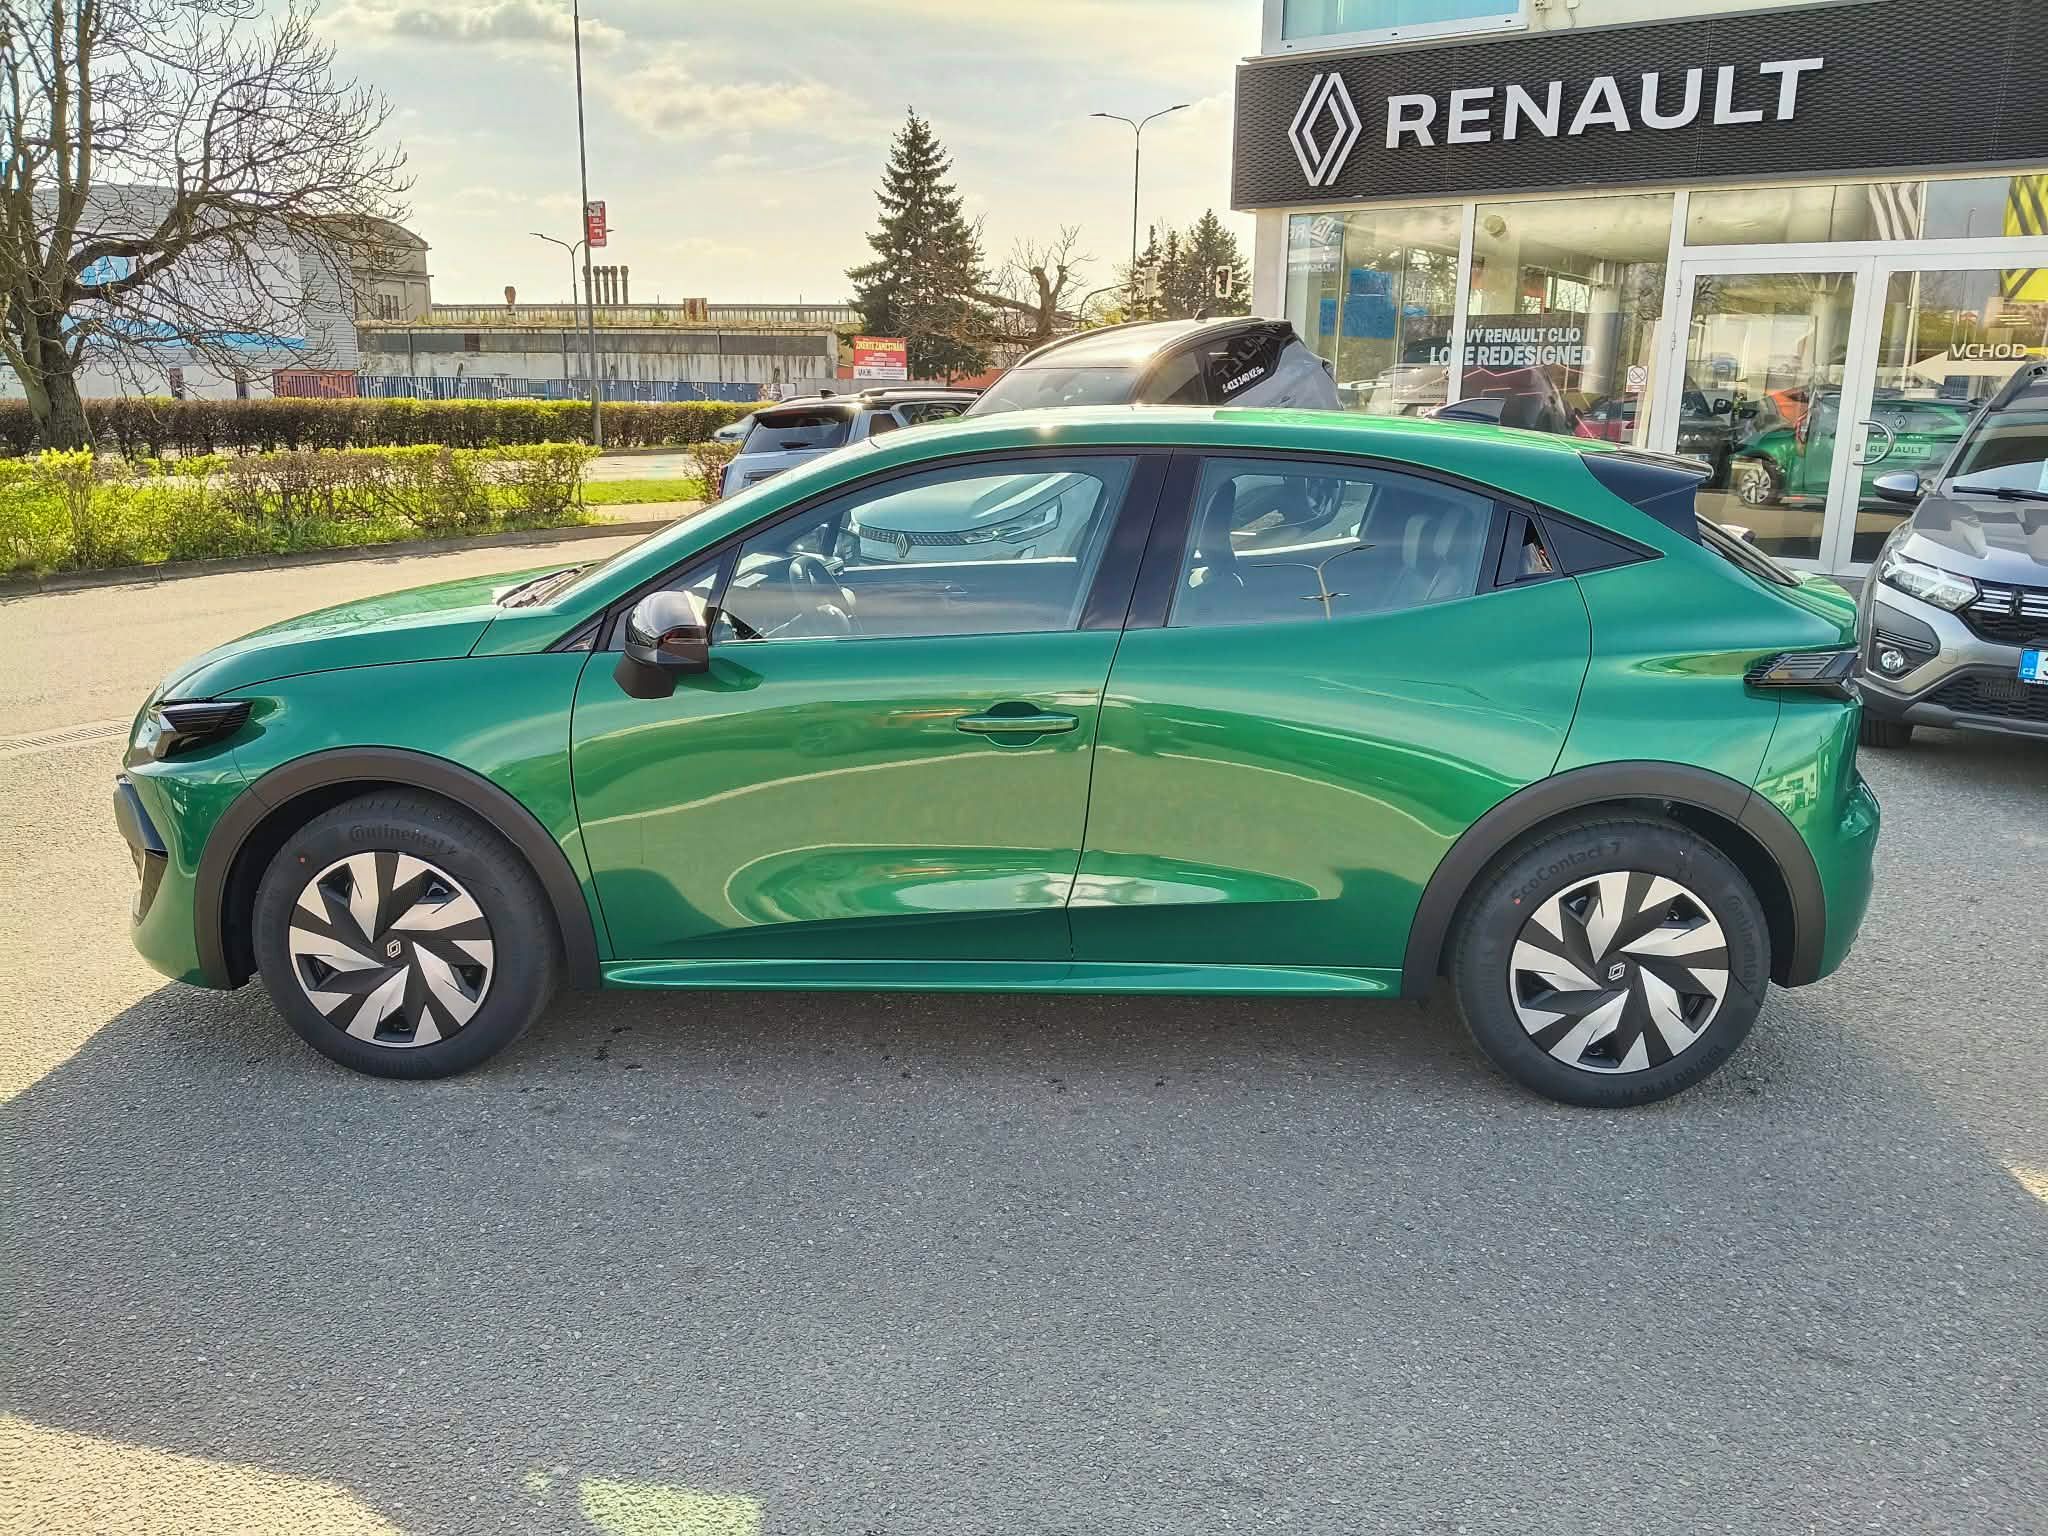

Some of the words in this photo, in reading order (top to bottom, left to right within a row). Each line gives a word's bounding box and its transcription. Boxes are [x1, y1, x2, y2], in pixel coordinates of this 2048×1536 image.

[1385, 57, 1824, 149] RENAULT
[1447, 325, 1485, 343] NVÝ
[1485, 328, 1546, 343] RENAULT
[1548, 327, 1580, 343] CLIO
[1429, 346, 1478, 366] LOE
[1478, 346, 1595, 366] REDESIGNED
[1951, 343, 2027, 359] VCHOD
[1870, 445, 1923, 454] REAULT
[2023, 667, 2034, 675] CZ
